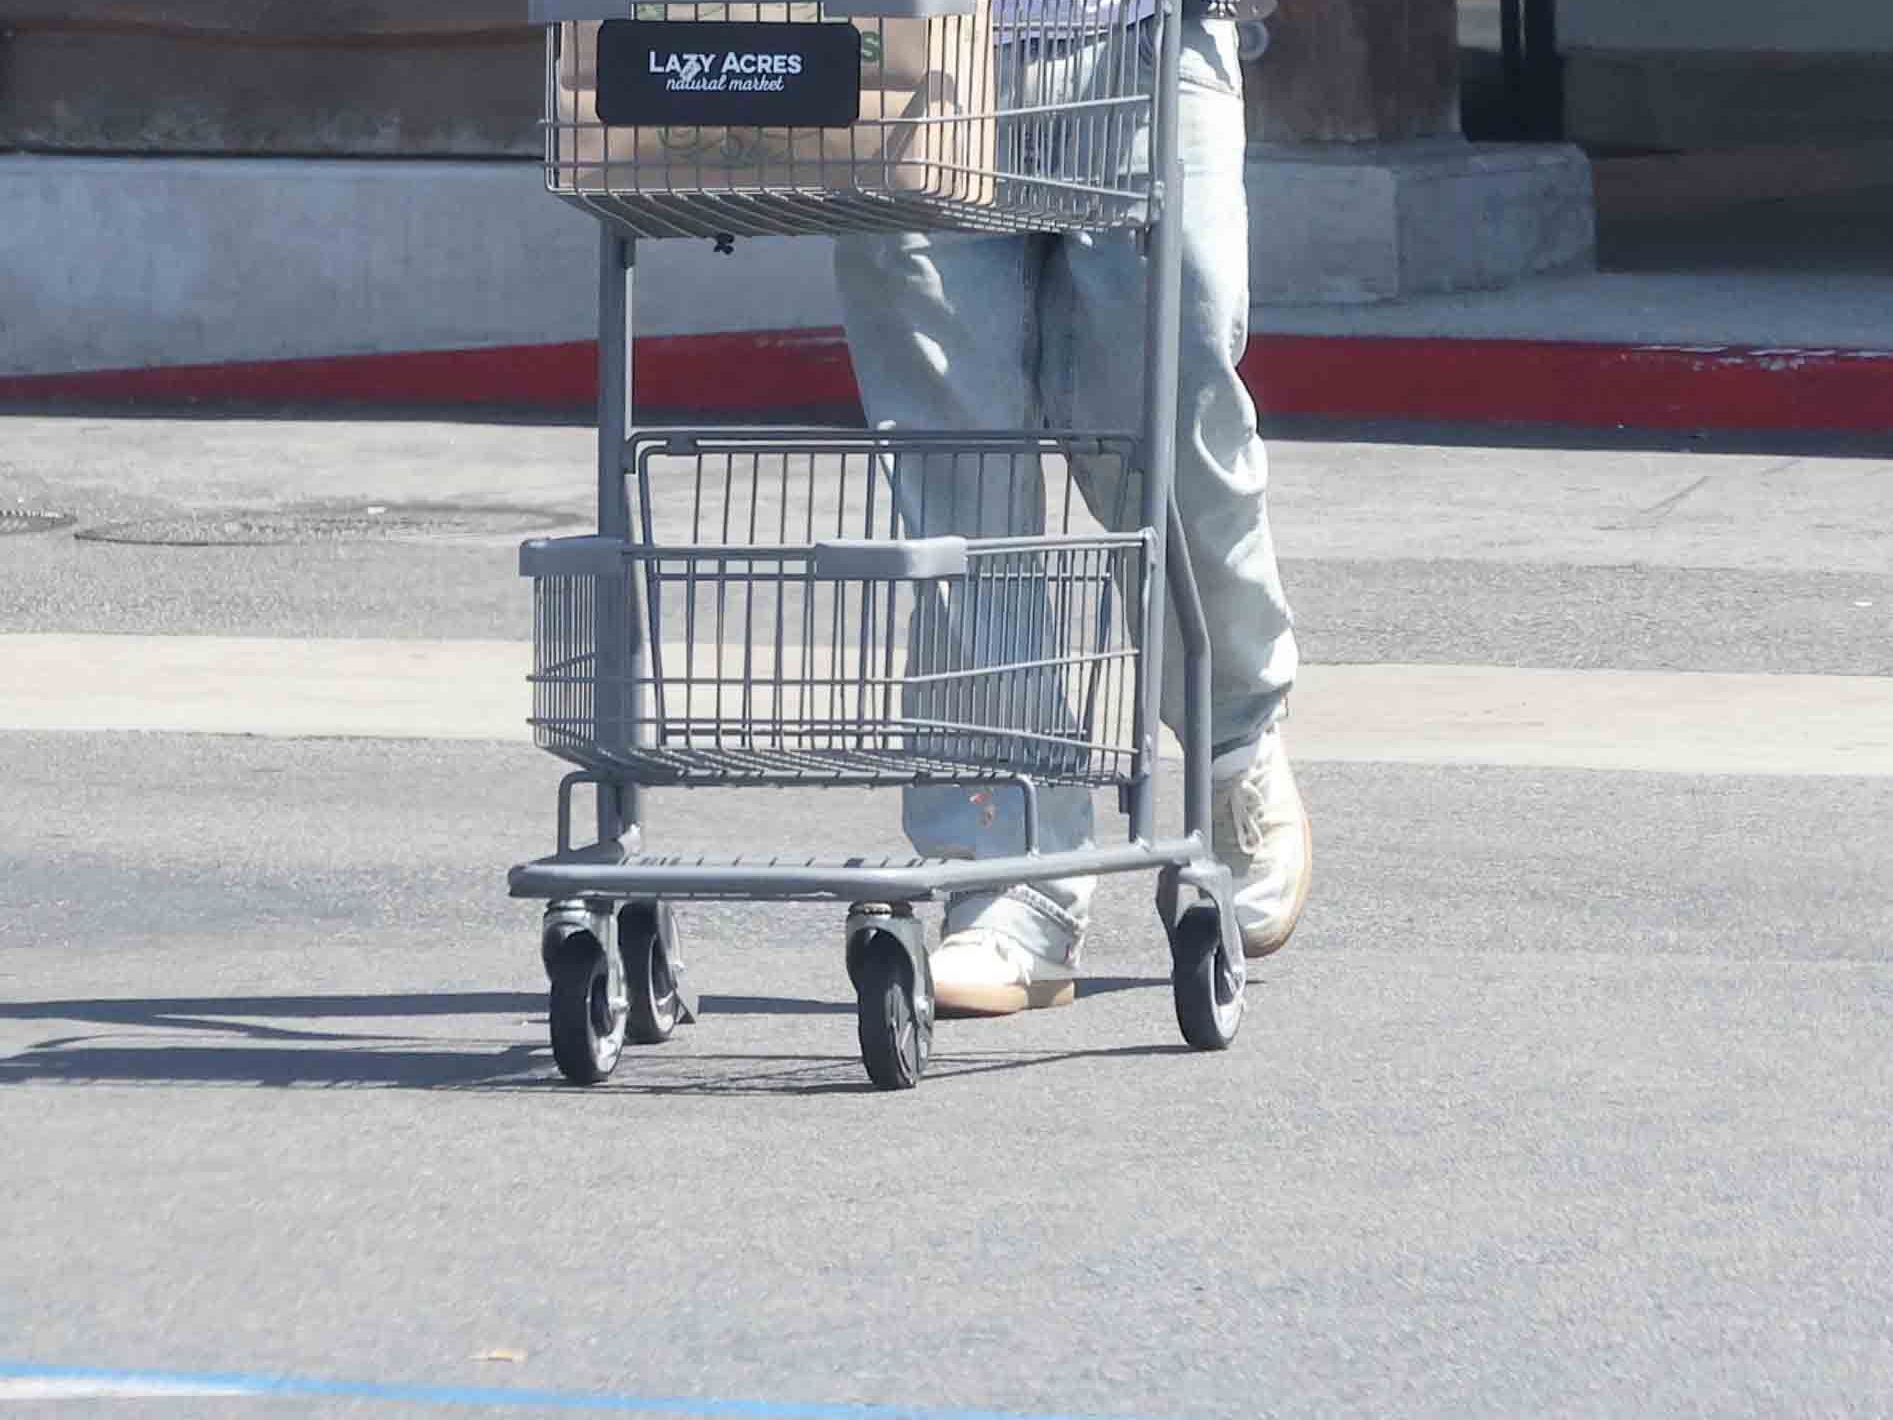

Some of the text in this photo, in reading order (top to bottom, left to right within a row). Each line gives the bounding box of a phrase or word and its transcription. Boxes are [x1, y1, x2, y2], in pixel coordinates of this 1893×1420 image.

[649, 51, 804, 78] LAZY ACRES
[665, 73, 785, 92] natural market
